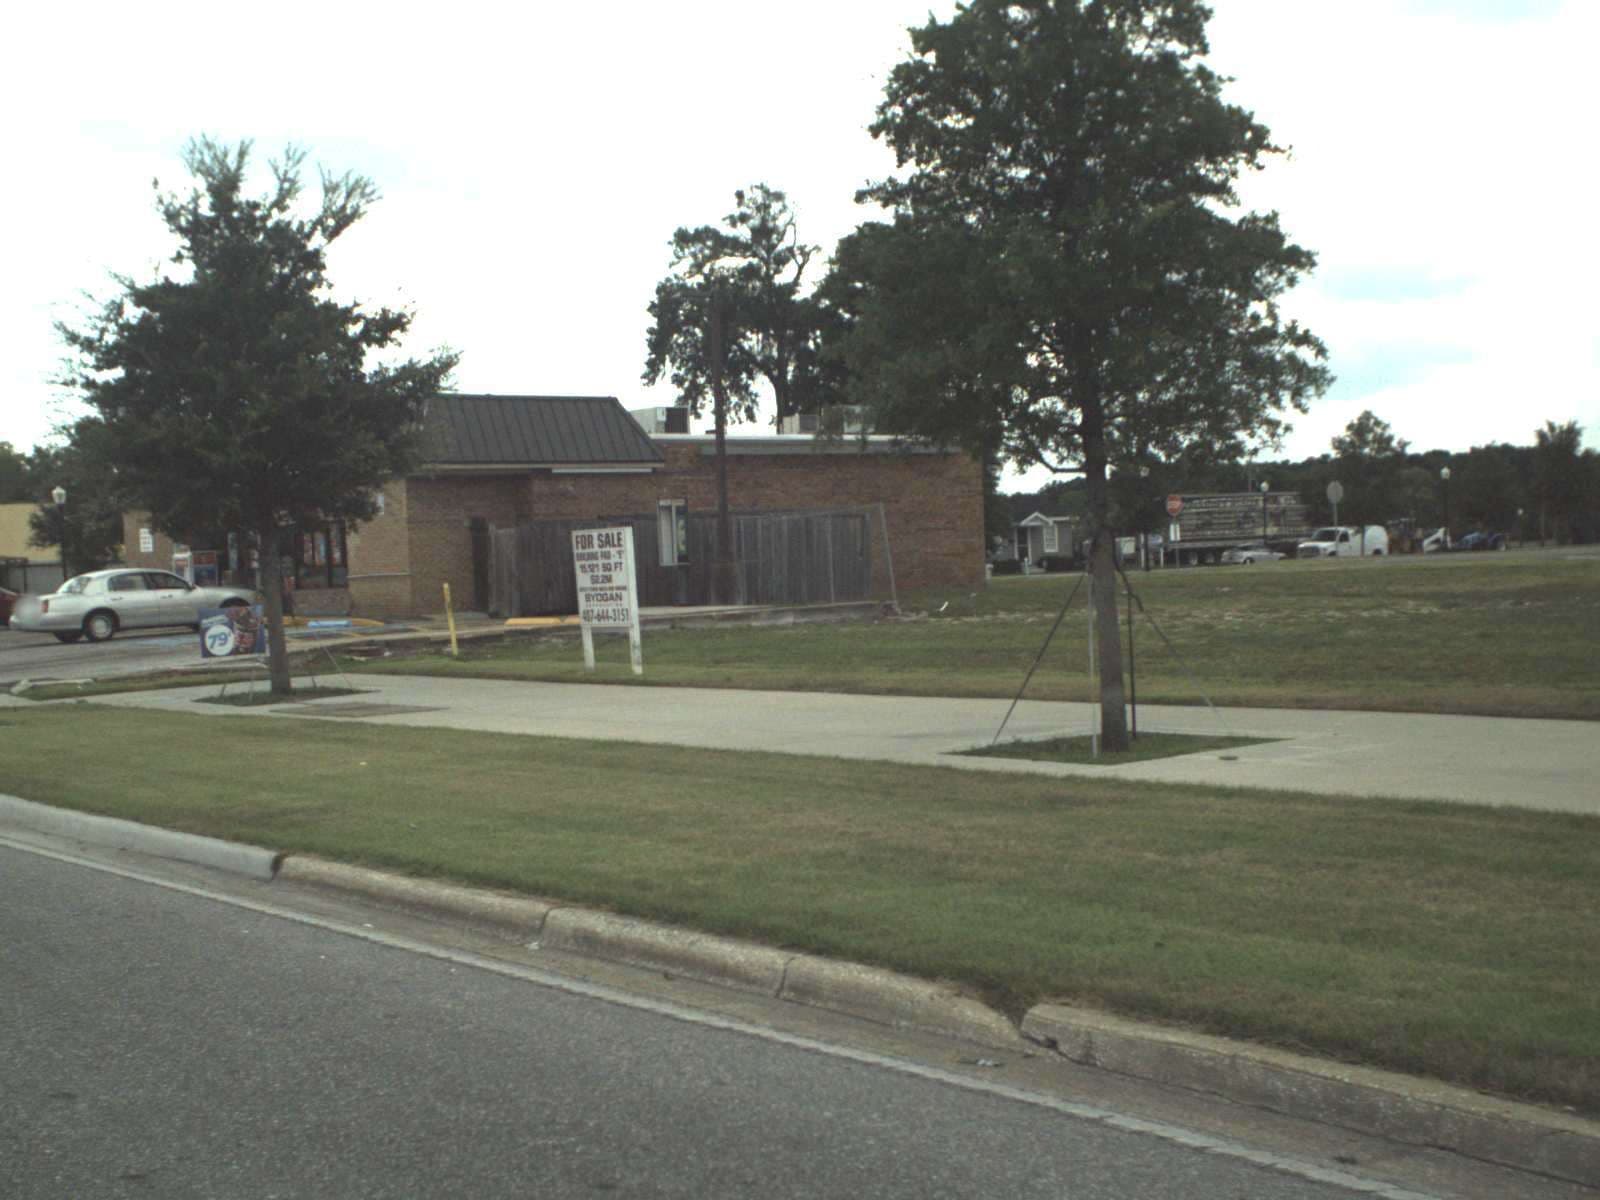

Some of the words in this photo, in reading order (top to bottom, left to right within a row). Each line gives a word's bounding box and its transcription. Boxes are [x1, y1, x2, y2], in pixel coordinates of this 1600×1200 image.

[576, 534, 593, 549] FOR
[597, 532, 623, 548] SALE
[614, 561, 624, 571] FT
